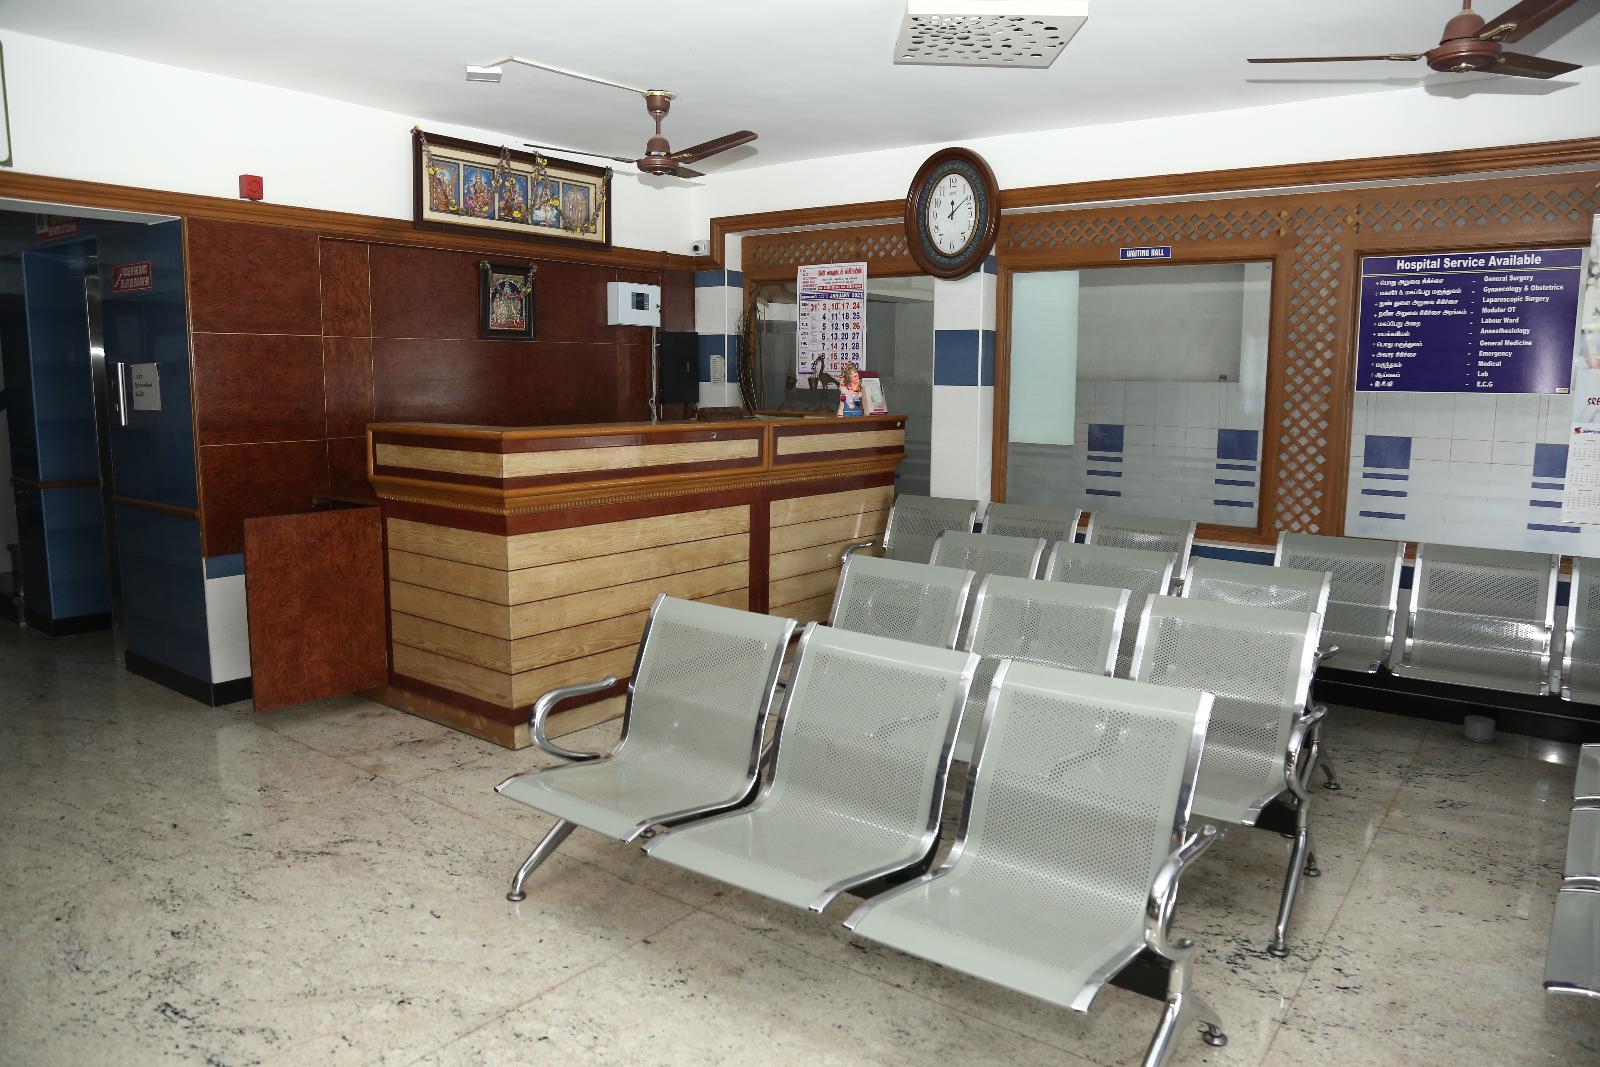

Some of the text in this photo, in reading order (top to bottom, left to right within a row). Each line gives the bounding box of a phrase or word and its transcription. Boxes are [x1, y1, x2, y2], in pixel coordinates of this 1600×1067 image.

[949, 177, 957, 188] 12
[934, 198, 941, 208] 10
[1396, 254, 1542, 271] Hospital Service Available
[1482, 295, 1549, 304] Laparoscopic Surgery
[810, 304, 817, 312] 31
[852, 352, 859, 360] 29
